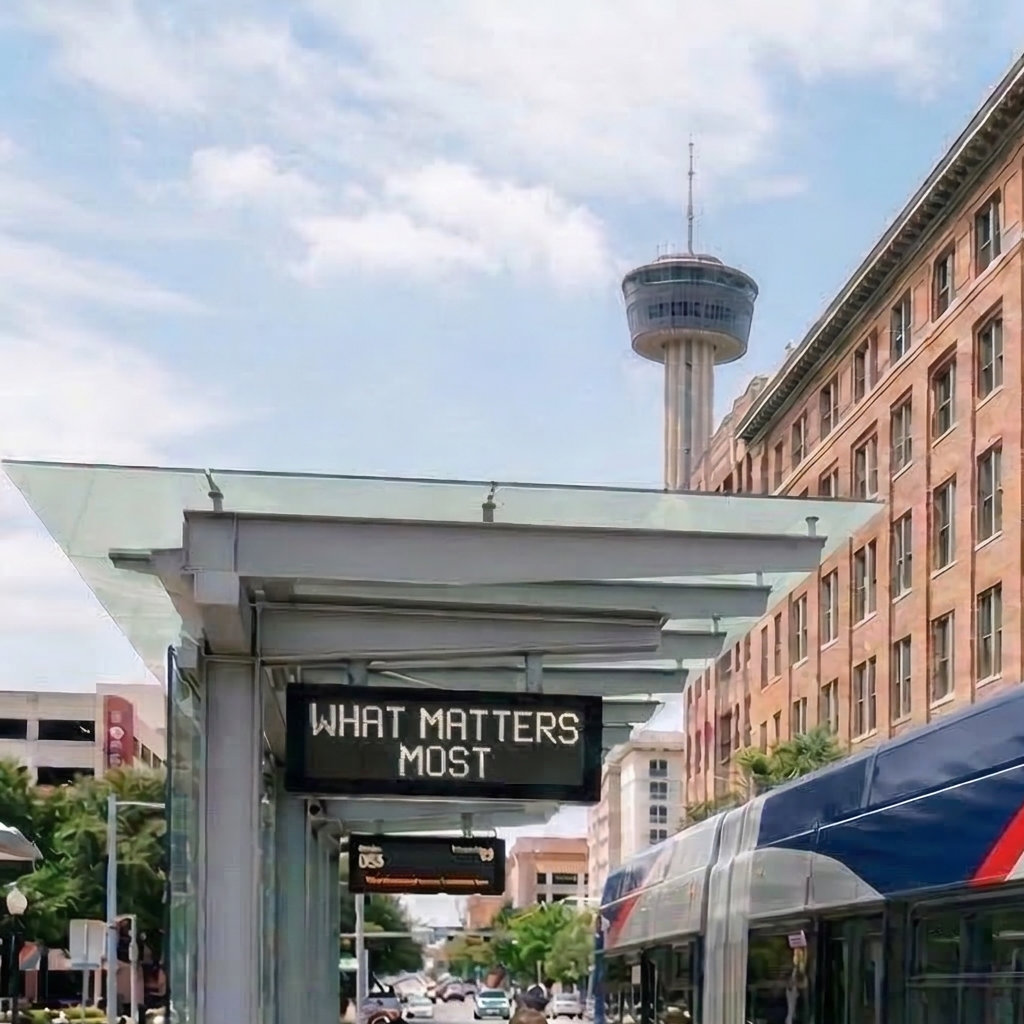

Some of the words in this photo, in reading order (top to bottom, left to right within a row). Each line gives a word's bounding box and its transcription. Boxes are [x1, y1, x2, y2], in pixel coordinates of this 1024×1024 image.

[309, 701, 406, 739] WHAT
[419, 707, 580, 746] MATTERS
[399, 743, 491, 779] MOST
